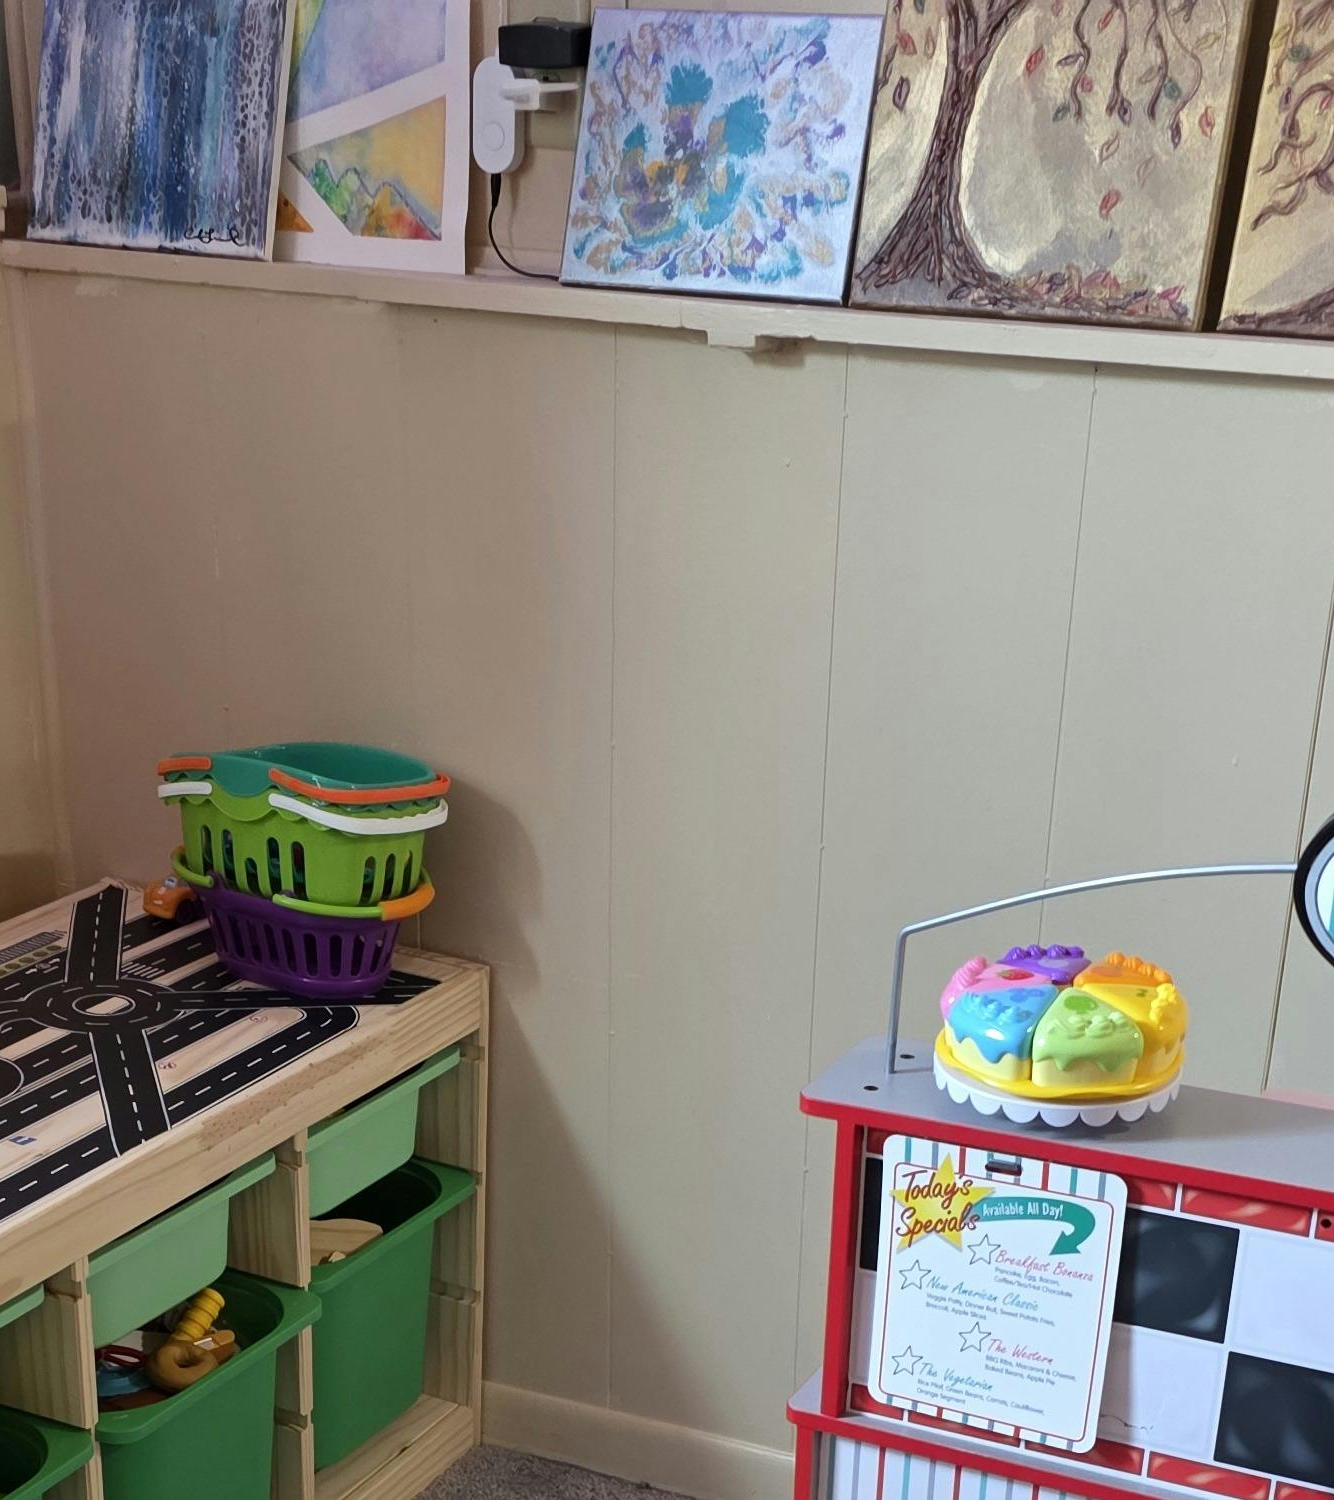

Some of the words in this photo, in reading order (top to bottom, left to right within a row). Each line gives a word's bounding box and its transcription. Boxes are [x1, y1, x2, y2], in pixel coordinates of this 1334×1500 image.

[902, 1170, 973, 1209] Today's
[896, 1202, 980, 1247] Specials
[983, 1204, 1024, 1217] Available
[1027, 1202, 1039, 1215] All
[1042, 1203, 1063, 1219] Day!
[995, 1249, 1050, 1274] Breakfast
[1053, 1262, 1094, 1282] Bonanza
[927, 1276, 949, 1290] New
[952, 1281, 998, 1302] American
[1002, 1292, 1039, 1311] Classic
[988, 1338, 1007, 1354] The
[1012, 1343, 1054, 1365] Western
[919, 1362, 938, 1377] The
[943, 1368, 993, 1391] Vegetarian
